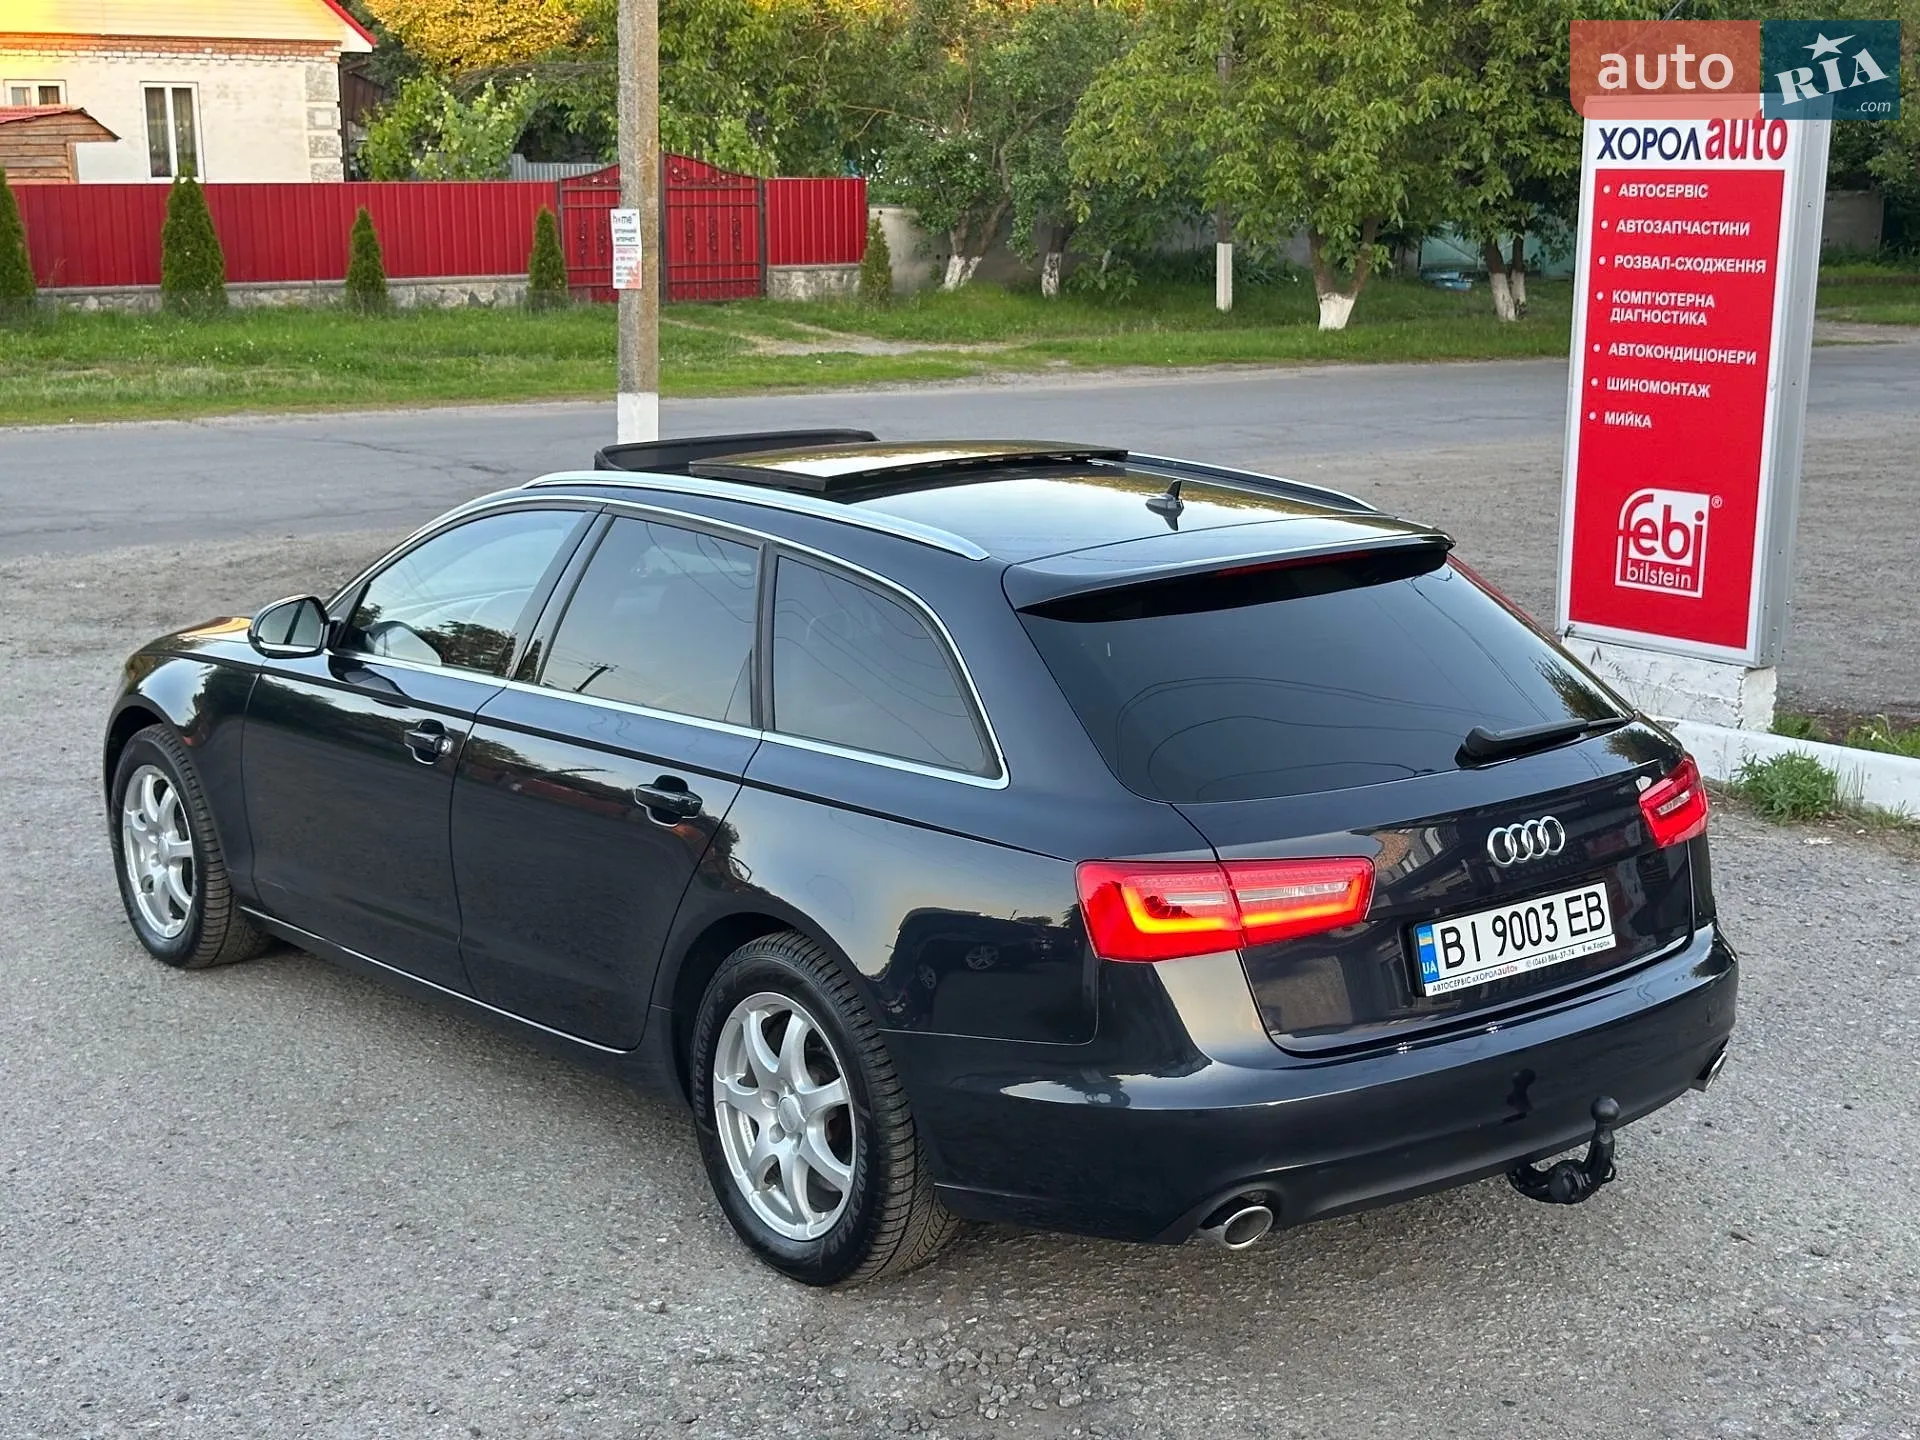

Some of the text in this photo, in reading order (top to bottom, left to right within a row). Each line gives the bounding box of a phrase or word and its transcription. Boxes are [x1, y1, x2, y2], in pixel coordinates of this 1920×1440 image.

[1618, 183, 1709, 199] АВТОСЕРВІС
[1616, 219, 1750, 237] АВТОЗАПЧАСТИНИ
[1614, 256, 1767, 274] РОЗВАЛ-СХОДЖЕННЯ
[1610, 308, 1707, 326] ДІАГНОСТИКА
[1608, 343, 1757, 365] АВТОКОНДИЦІОНЕРИ
[1606, 377, 1711, 398] ШИНОМОНТАЖ
[1604, 411, 1652, 428] МИЙКА
[1616, 493, 1705, 561] febi
[1626, 559, 1692, 589] bilstein
[1440, 891, 1606, 969] BI 9003 EB
[1423, 960, 1438, 975] UA
